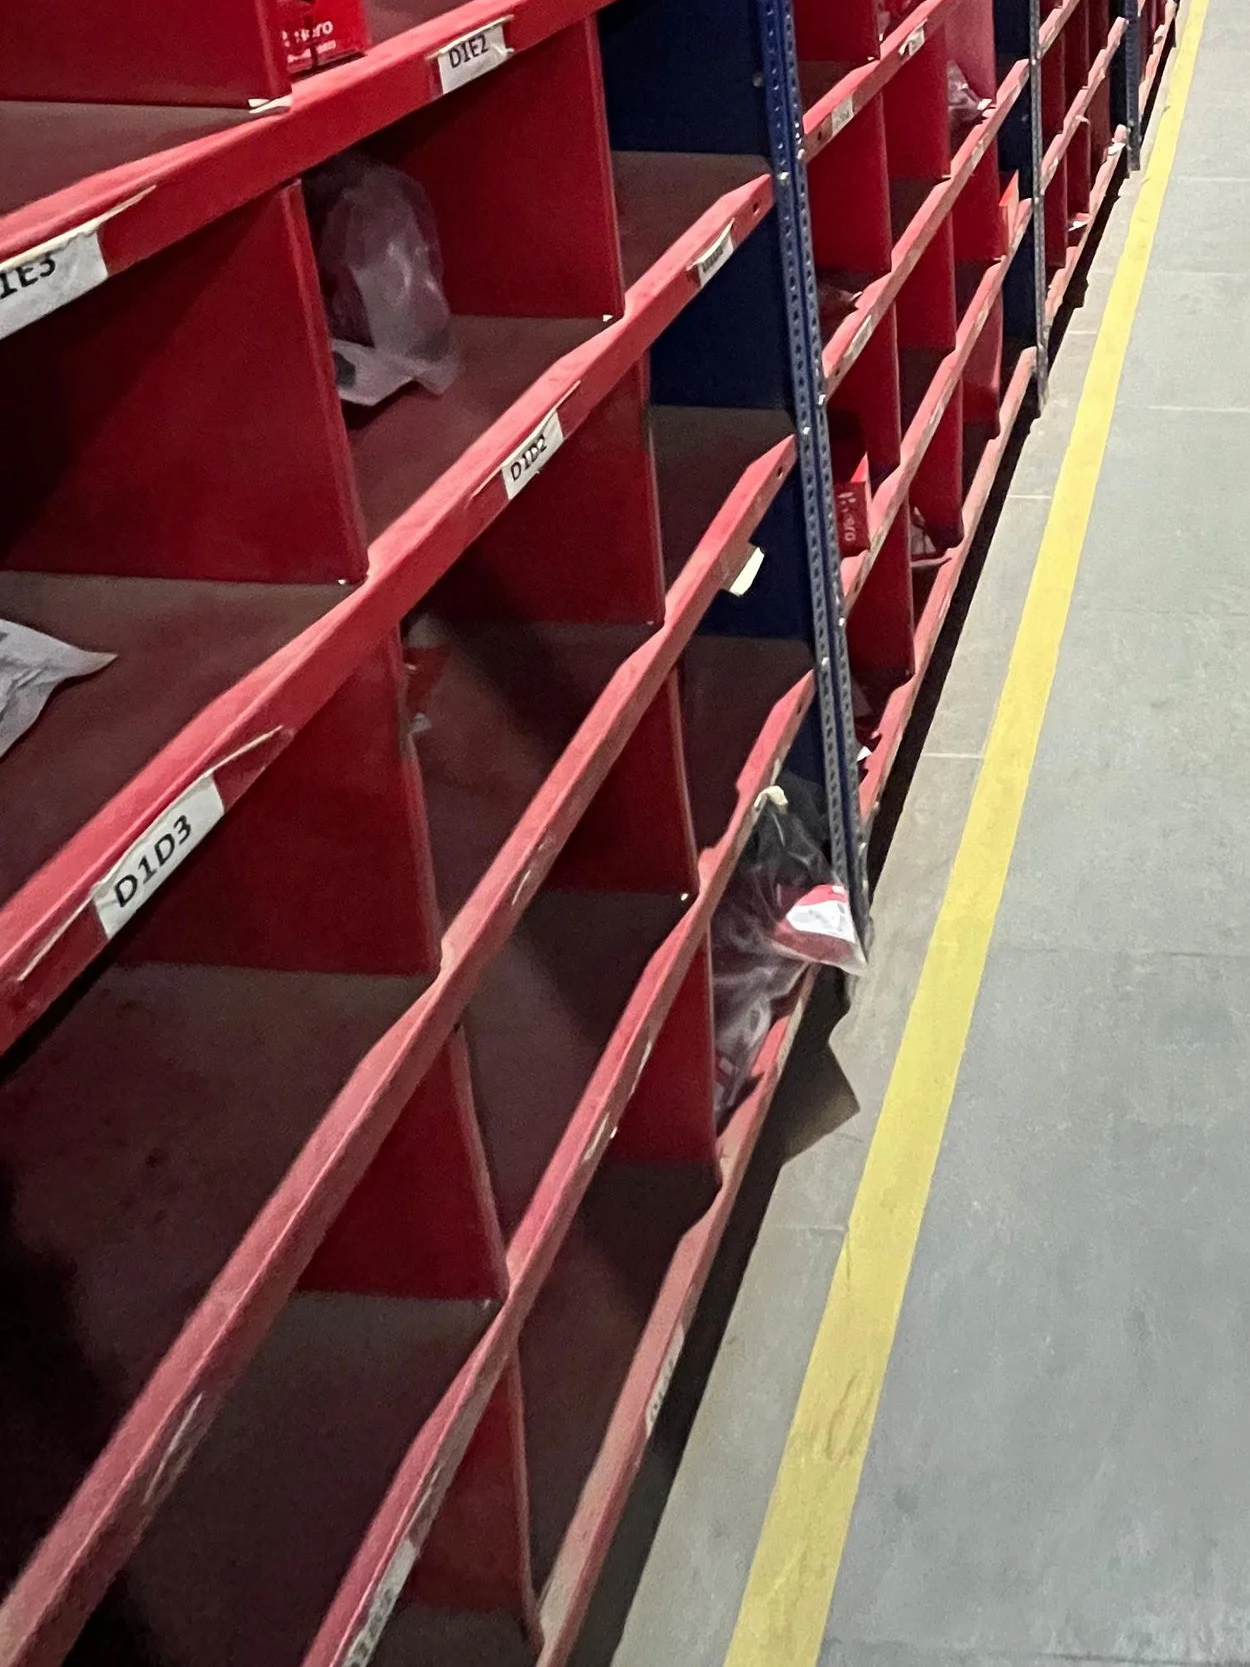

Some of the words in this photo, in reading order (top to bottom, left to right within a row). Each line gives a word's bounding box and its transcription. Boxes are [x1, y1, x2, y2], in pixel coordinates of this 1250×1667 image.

[448, 33, 489, 70] D1E2
[0, 255, 57, 301] 1E3
[510, 435, 548, 483] D1D2
[114, 814, 193, 909] D1D3
